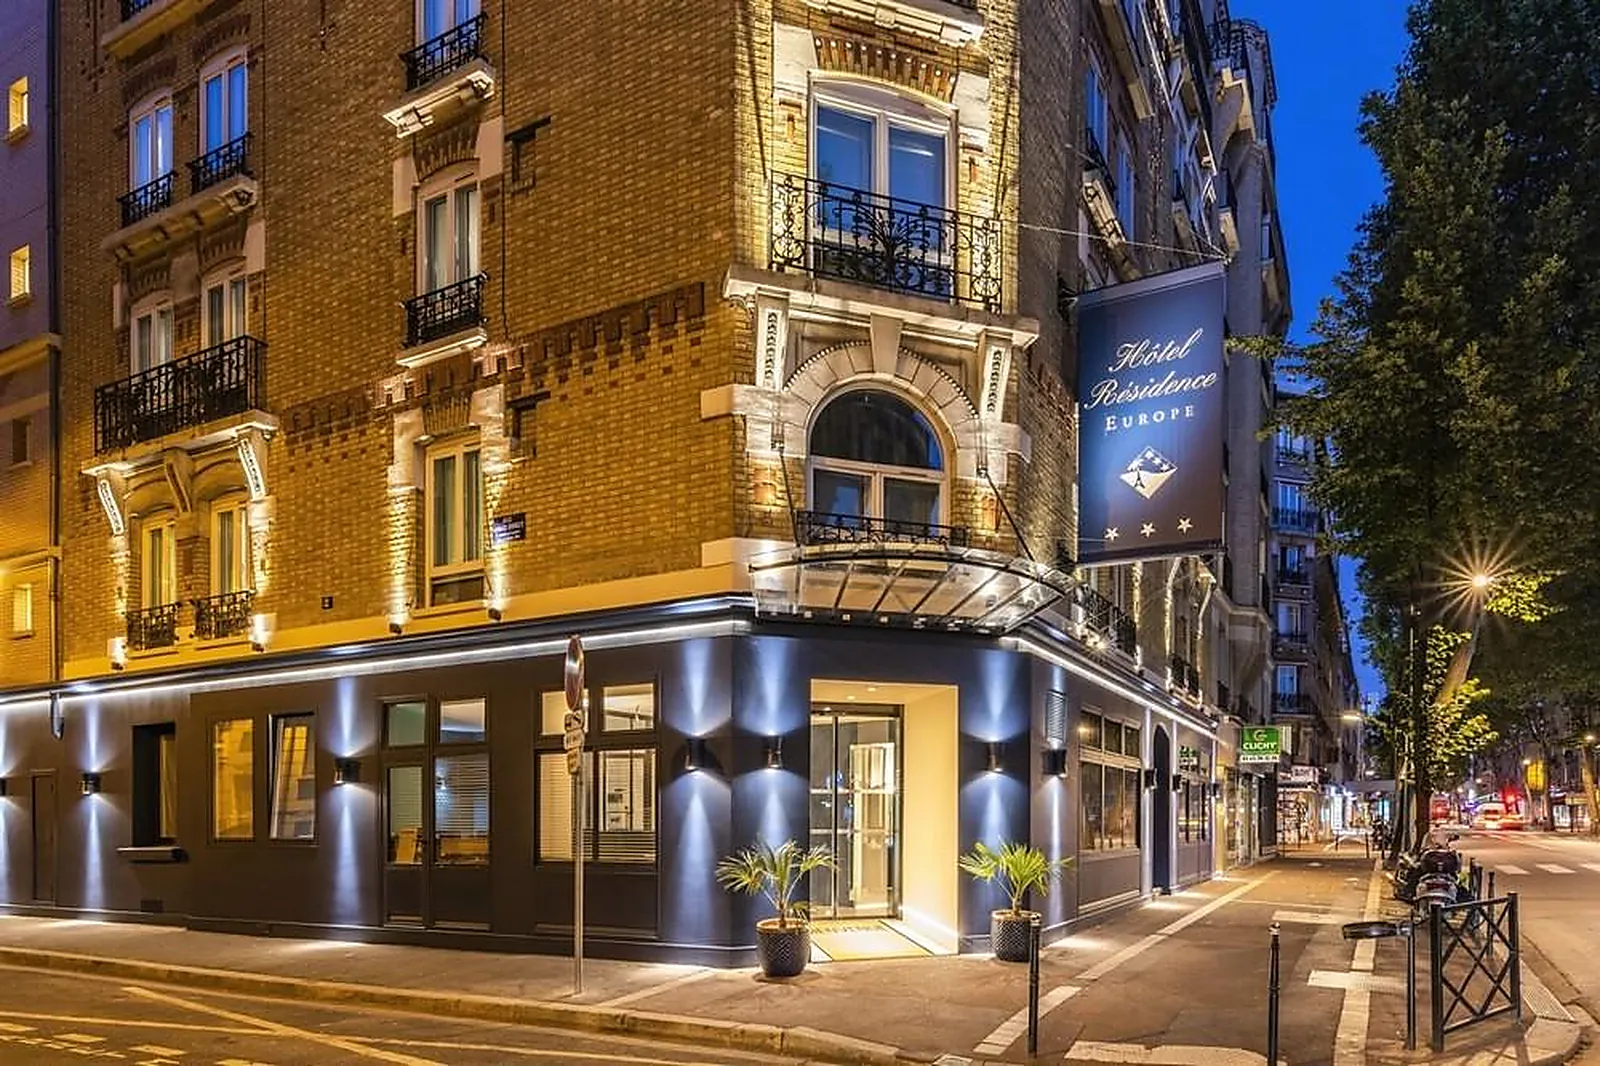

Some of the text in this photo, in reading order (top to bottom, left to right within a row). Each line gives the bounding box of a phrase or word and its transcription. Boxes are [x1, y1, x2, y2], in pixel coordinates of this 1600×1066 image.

[1108, 328, 1203, 372] Hôtel
[1084, 371, 1217, 410] Résidence
[1106, 405, 1195, 431] EUROPE
